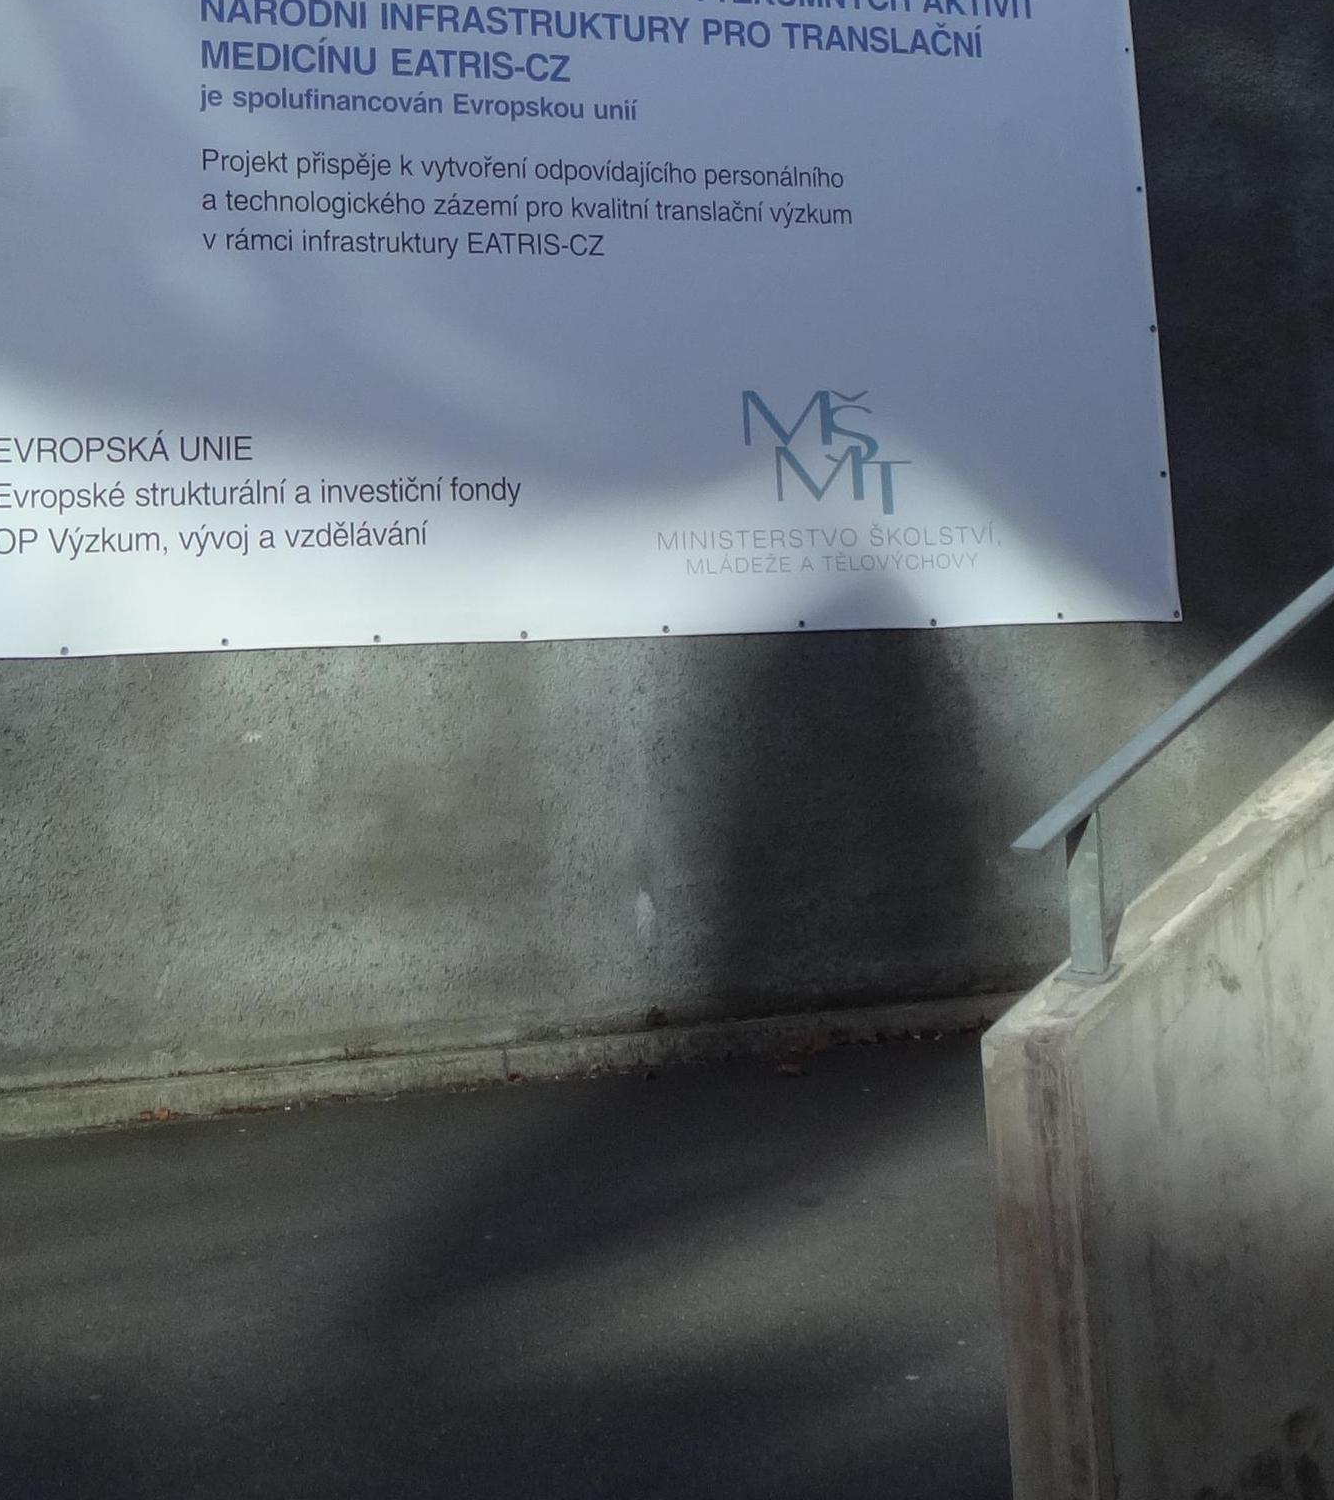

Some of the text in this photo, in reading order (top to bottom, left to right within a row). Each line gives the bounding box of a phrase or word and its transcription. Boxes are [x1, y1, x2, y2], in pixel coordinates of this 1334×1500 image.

[380, 2, 690, 45] INFRASTRUKTURY
[701, 17, 773, 49] PRO
[780, 21, 983, 59] TRANSLAČNÍ
[200, 34, 572, 83] MEDICÍNU EATRIS-CZ
[199, 83, 639, 123] je spolufinancován Evropskou unií
[201, 149, 845, 191] Projekt přispěje k vytvoření odpovídajícího personálního
[201, 189, 853, 228] a technologického zázemí pro kvalitní translační výzkum
[202, 227, 604, 260] v rámci infrastruktury EATRIS-CZ
[179, 435, 254, 463] UNIE
[135, 479, 286, 507] strukturální
[294, 483, 313, 505] a
[319, 477, 444, 504] investiční
[448, 475, 522, 508] fondy
[50, 524, 169, 560] Výzkum,
[179, 523, 251, 557] vývoj
[258, 528, 277, 550] a
[283, 517, 429, 549] vzdělávání
[657, 520, 1001, 550] MINISTERSTVO ŠKOLSTVÍ,
[685, 549, 978, 576] MLÁDEŽE A TĚLOVÝCHOVY
